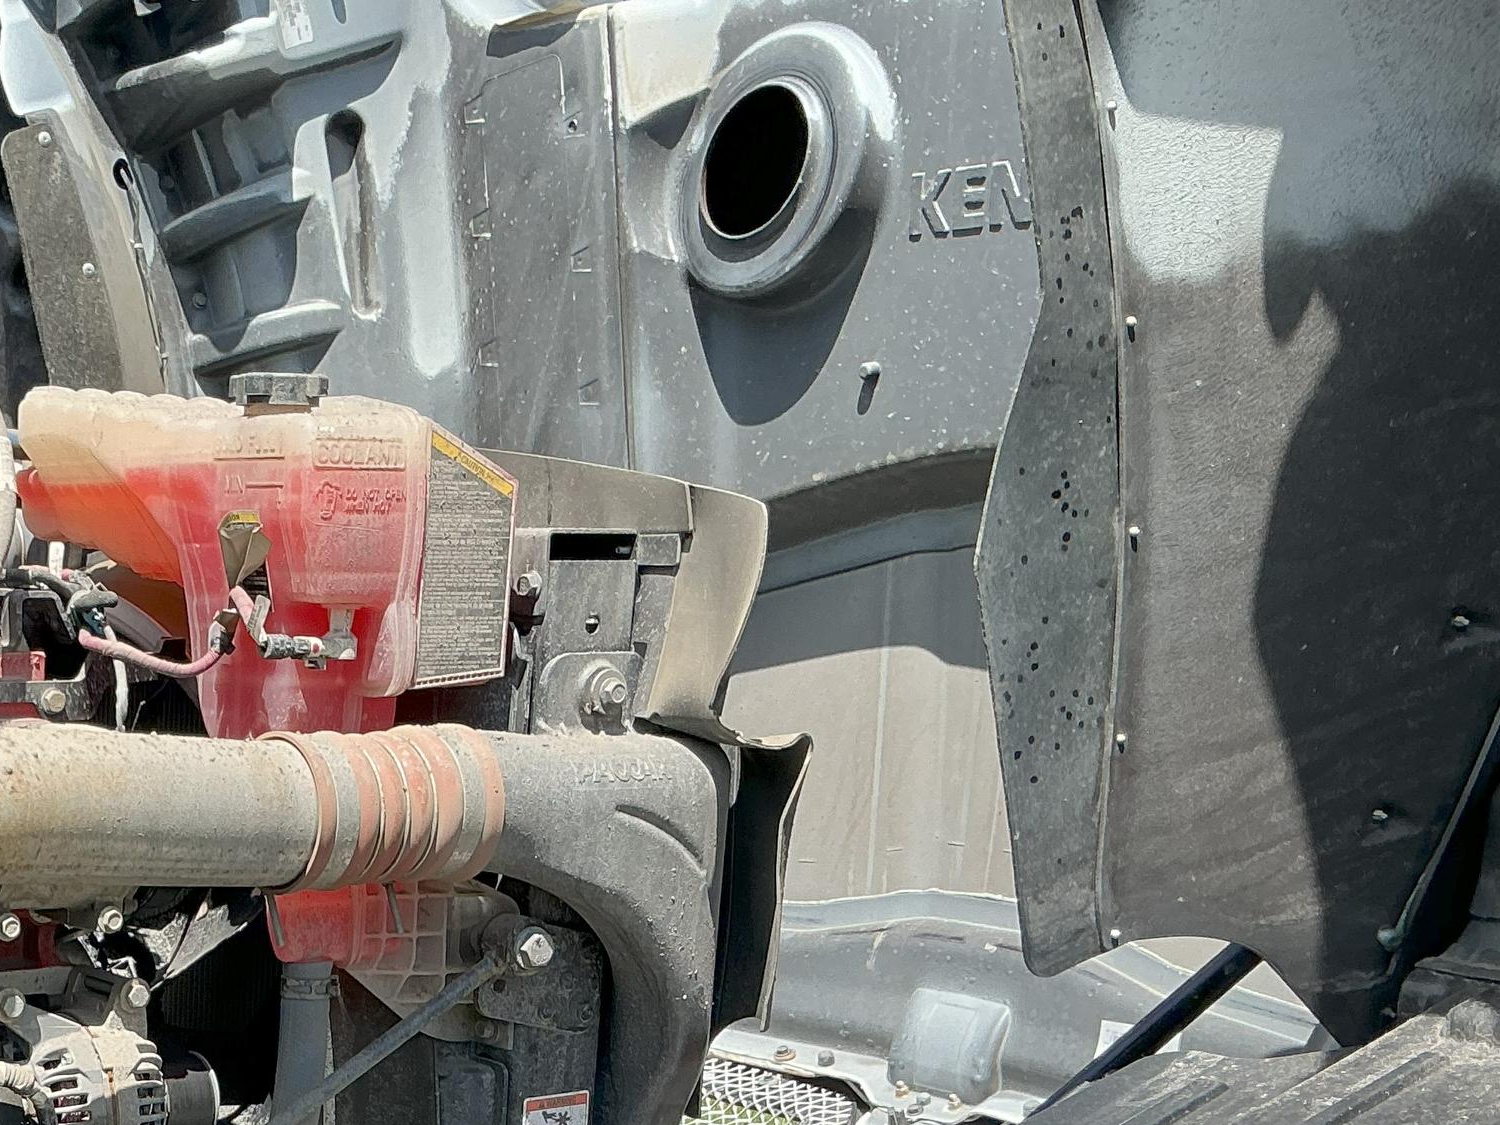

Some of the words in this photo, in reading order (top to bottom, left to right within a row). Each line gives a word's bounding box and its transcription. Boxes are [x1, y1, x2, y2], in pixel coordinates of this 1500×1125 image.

[909, 160, 1033, 242] KEN
[317, 442, 402, 467] COOLANT
[362, 487, 381, 501] NOT
